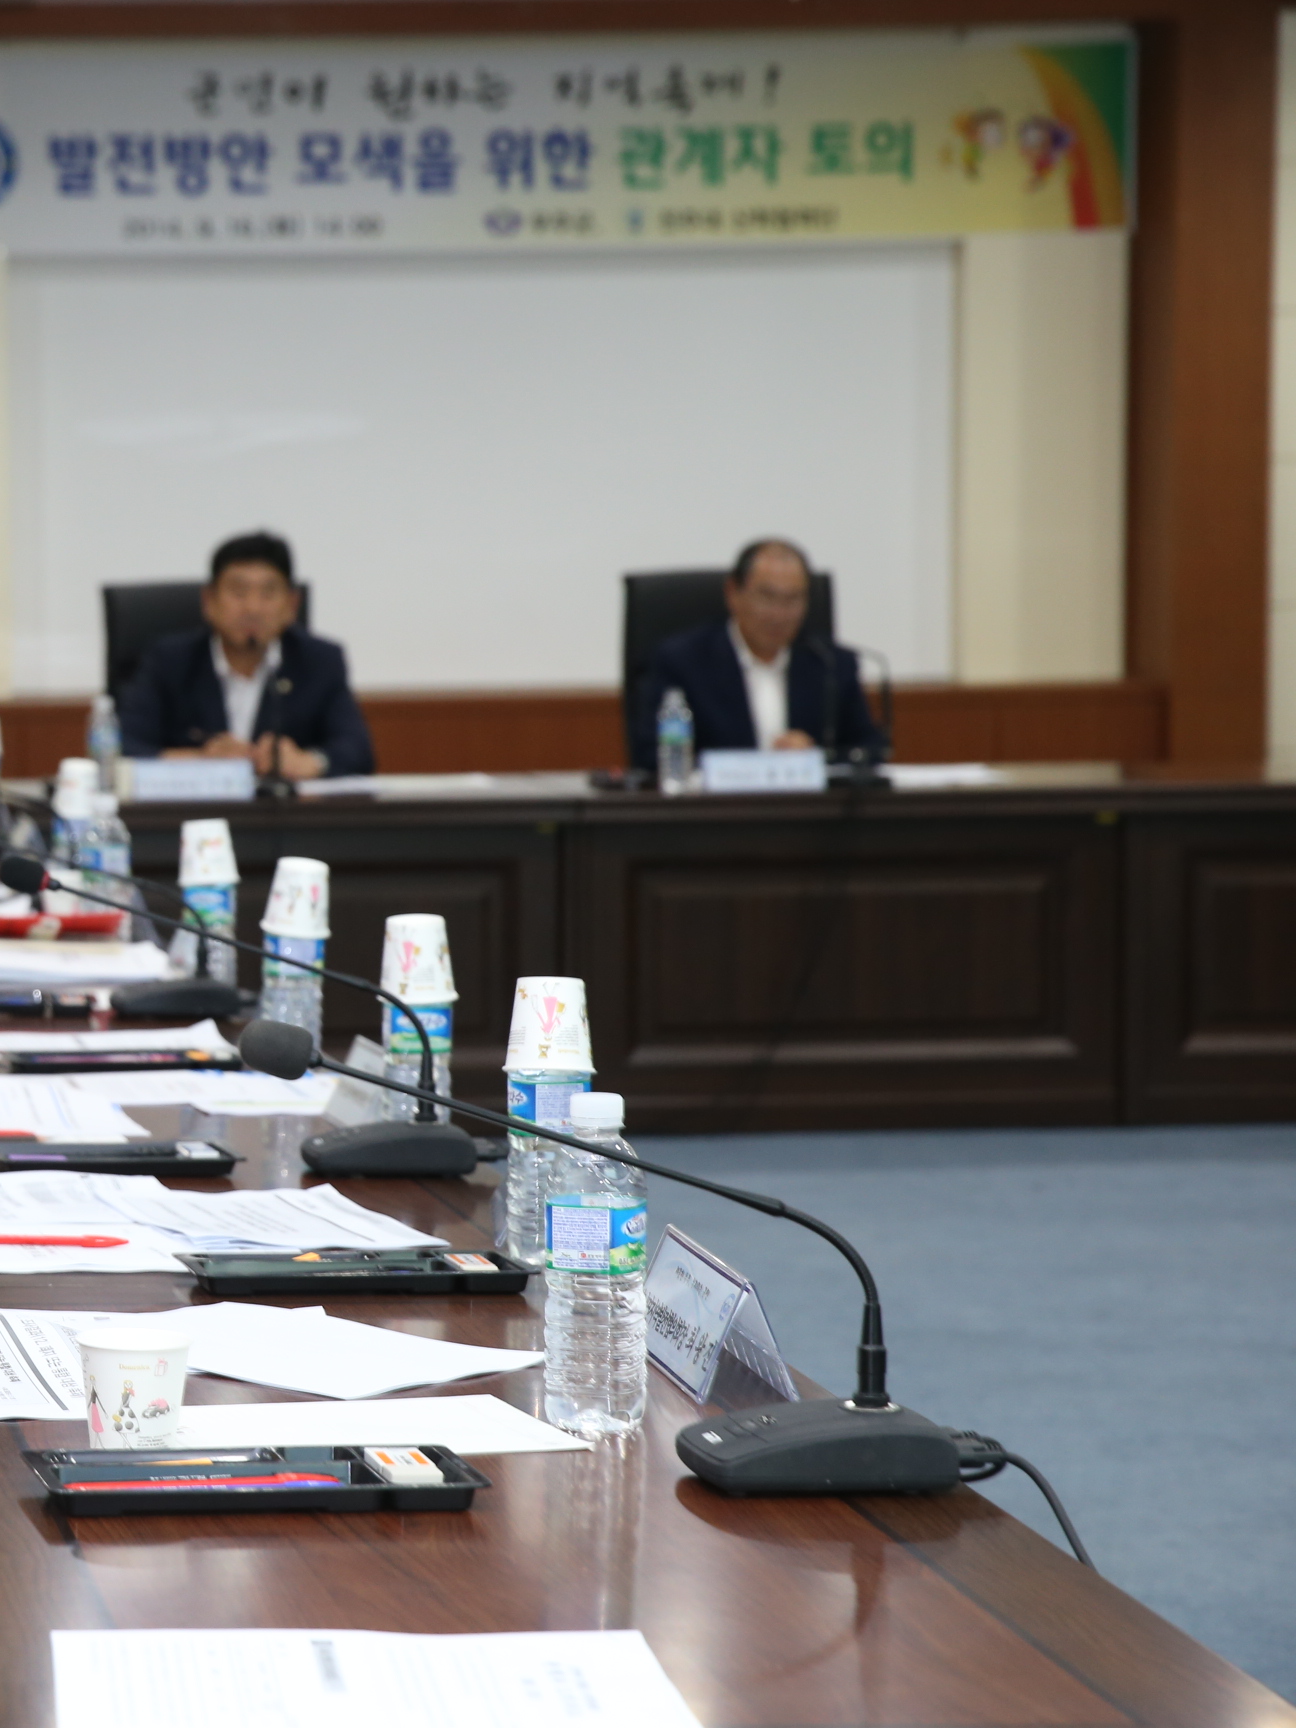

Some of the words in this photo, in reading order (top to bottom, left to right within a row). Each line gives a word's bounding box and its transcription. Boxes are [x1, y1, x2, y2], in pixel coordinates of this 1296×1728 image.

[48, 130, 271, 198] 발전방안
[298, 127, 461, 195] 모색을
[486, 126, 592, 190] 위한
[618, 122, 784, 191] 관계자
[807, 119, 917, 185] 토의
